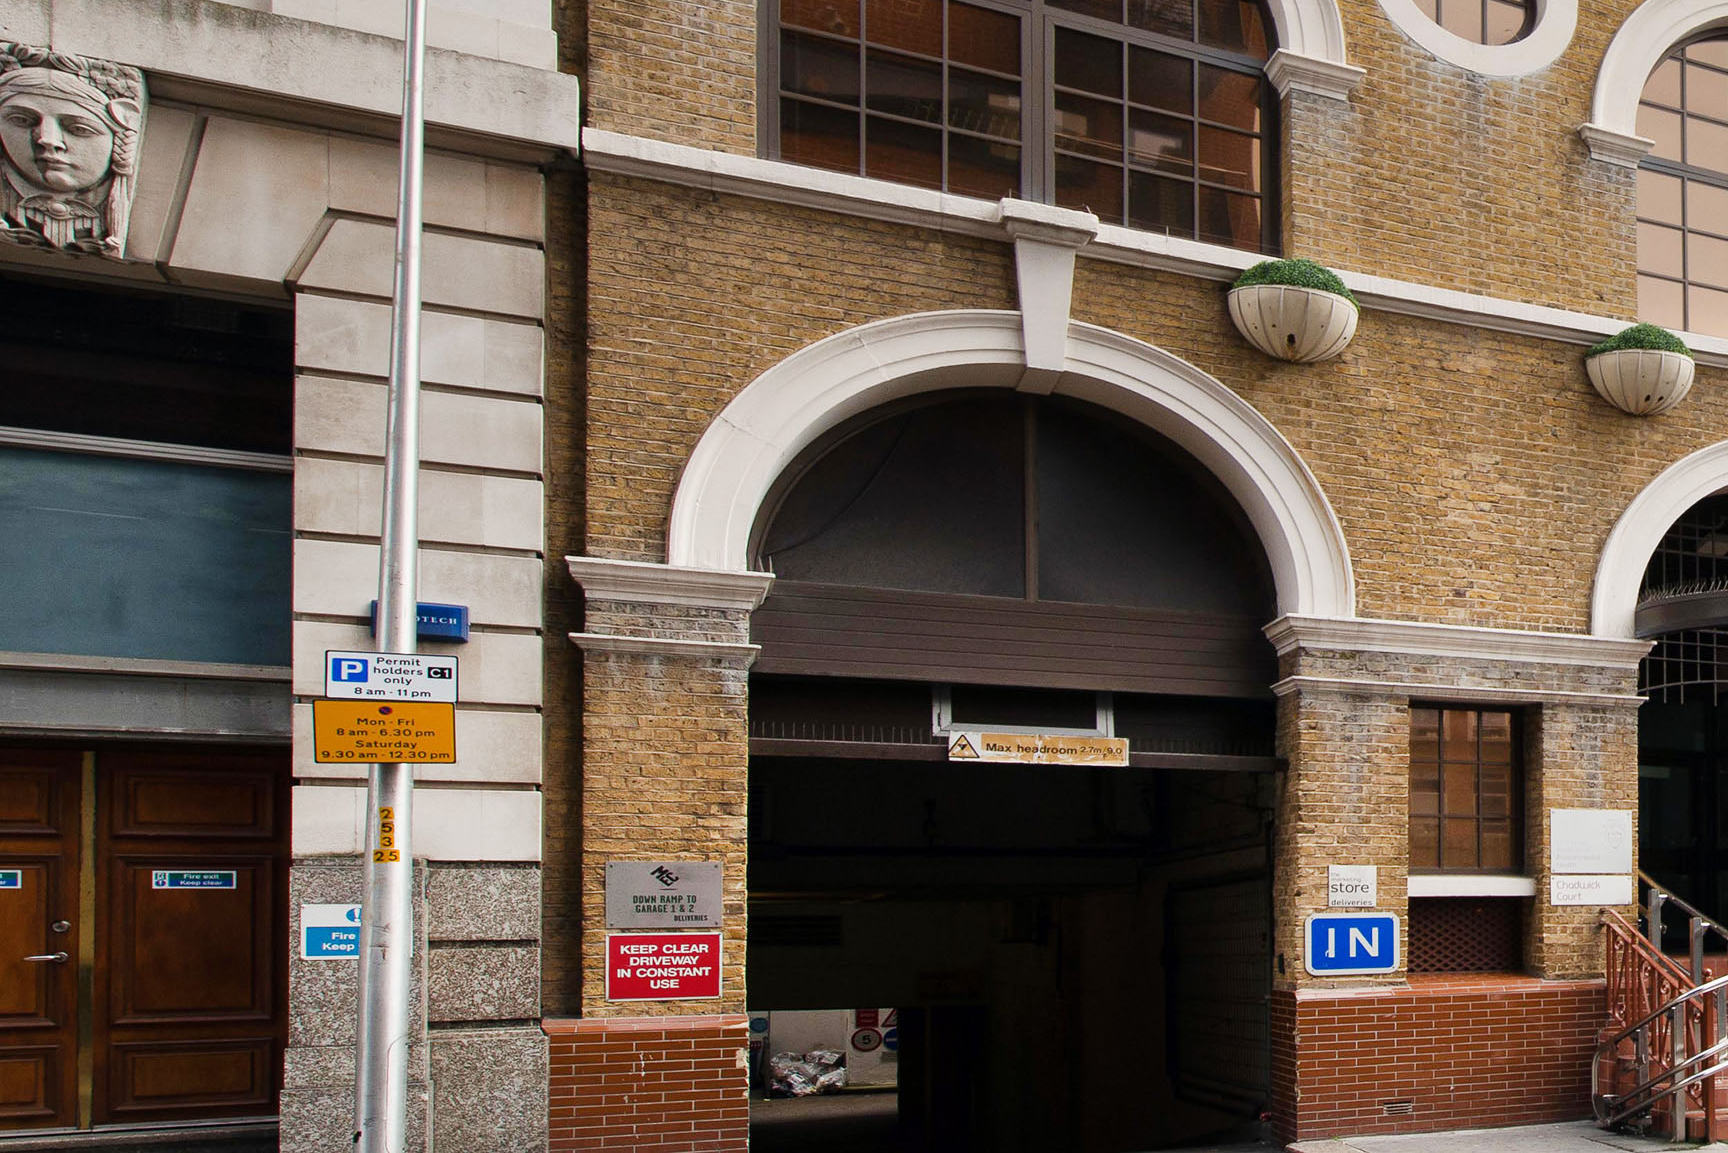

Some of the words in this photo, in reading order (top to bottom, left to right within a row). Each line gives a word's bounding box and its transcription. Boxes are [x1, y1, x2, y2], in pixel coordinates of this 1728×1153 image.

[376, 657, 421, 666] Permit
[341, 660, 363, 681] P
[373, 666, 423, 675] holders
[429, 668, 451, 678] C1
[384, 677, 412, 685] only
[354, 687, 363, 695] 8
[411, 690, 431, 698] pm
[357, 718, 386, 726] Mon
[336, 728, 345, 736] 8
[355, 740, 417, 749] Saturday
[986, 743, 1012, 752] Max
[1017, 744, 1077, 755] headroom
[321, 750, 355, 758] 9.30
[381, 809, 391, 819] 2
[381, 822, 392, 833] 5
[382, 837, 392, 847] 3
[1331, 882, 1369, 893] store
[1556, 880, 1600, 890] Chadwick
[633, 895, 656, 904] DOWN
[660, 895, 683, 903] RAMP
[687, 895, 697, 903] TO
[1556, 892, 1581, 901] Court
[635, 905, 668, 913] GARAGE
[332, 932, 356, 940] Fire
[322, 943, 355, 951] Keep
[1328, 927, 1379, 958] IN
[620, 944, 658, 954] KEEP
[662, 944, 709, 954] CLEAR
[629, 956, 699, 966] DRIVEWAY
[617, 968, 631, 978] IN
[636, 967, 712, 977] CONSTANT
[650, 979, 680, 989] USE
[862, 1035, 871, 1044] 5
